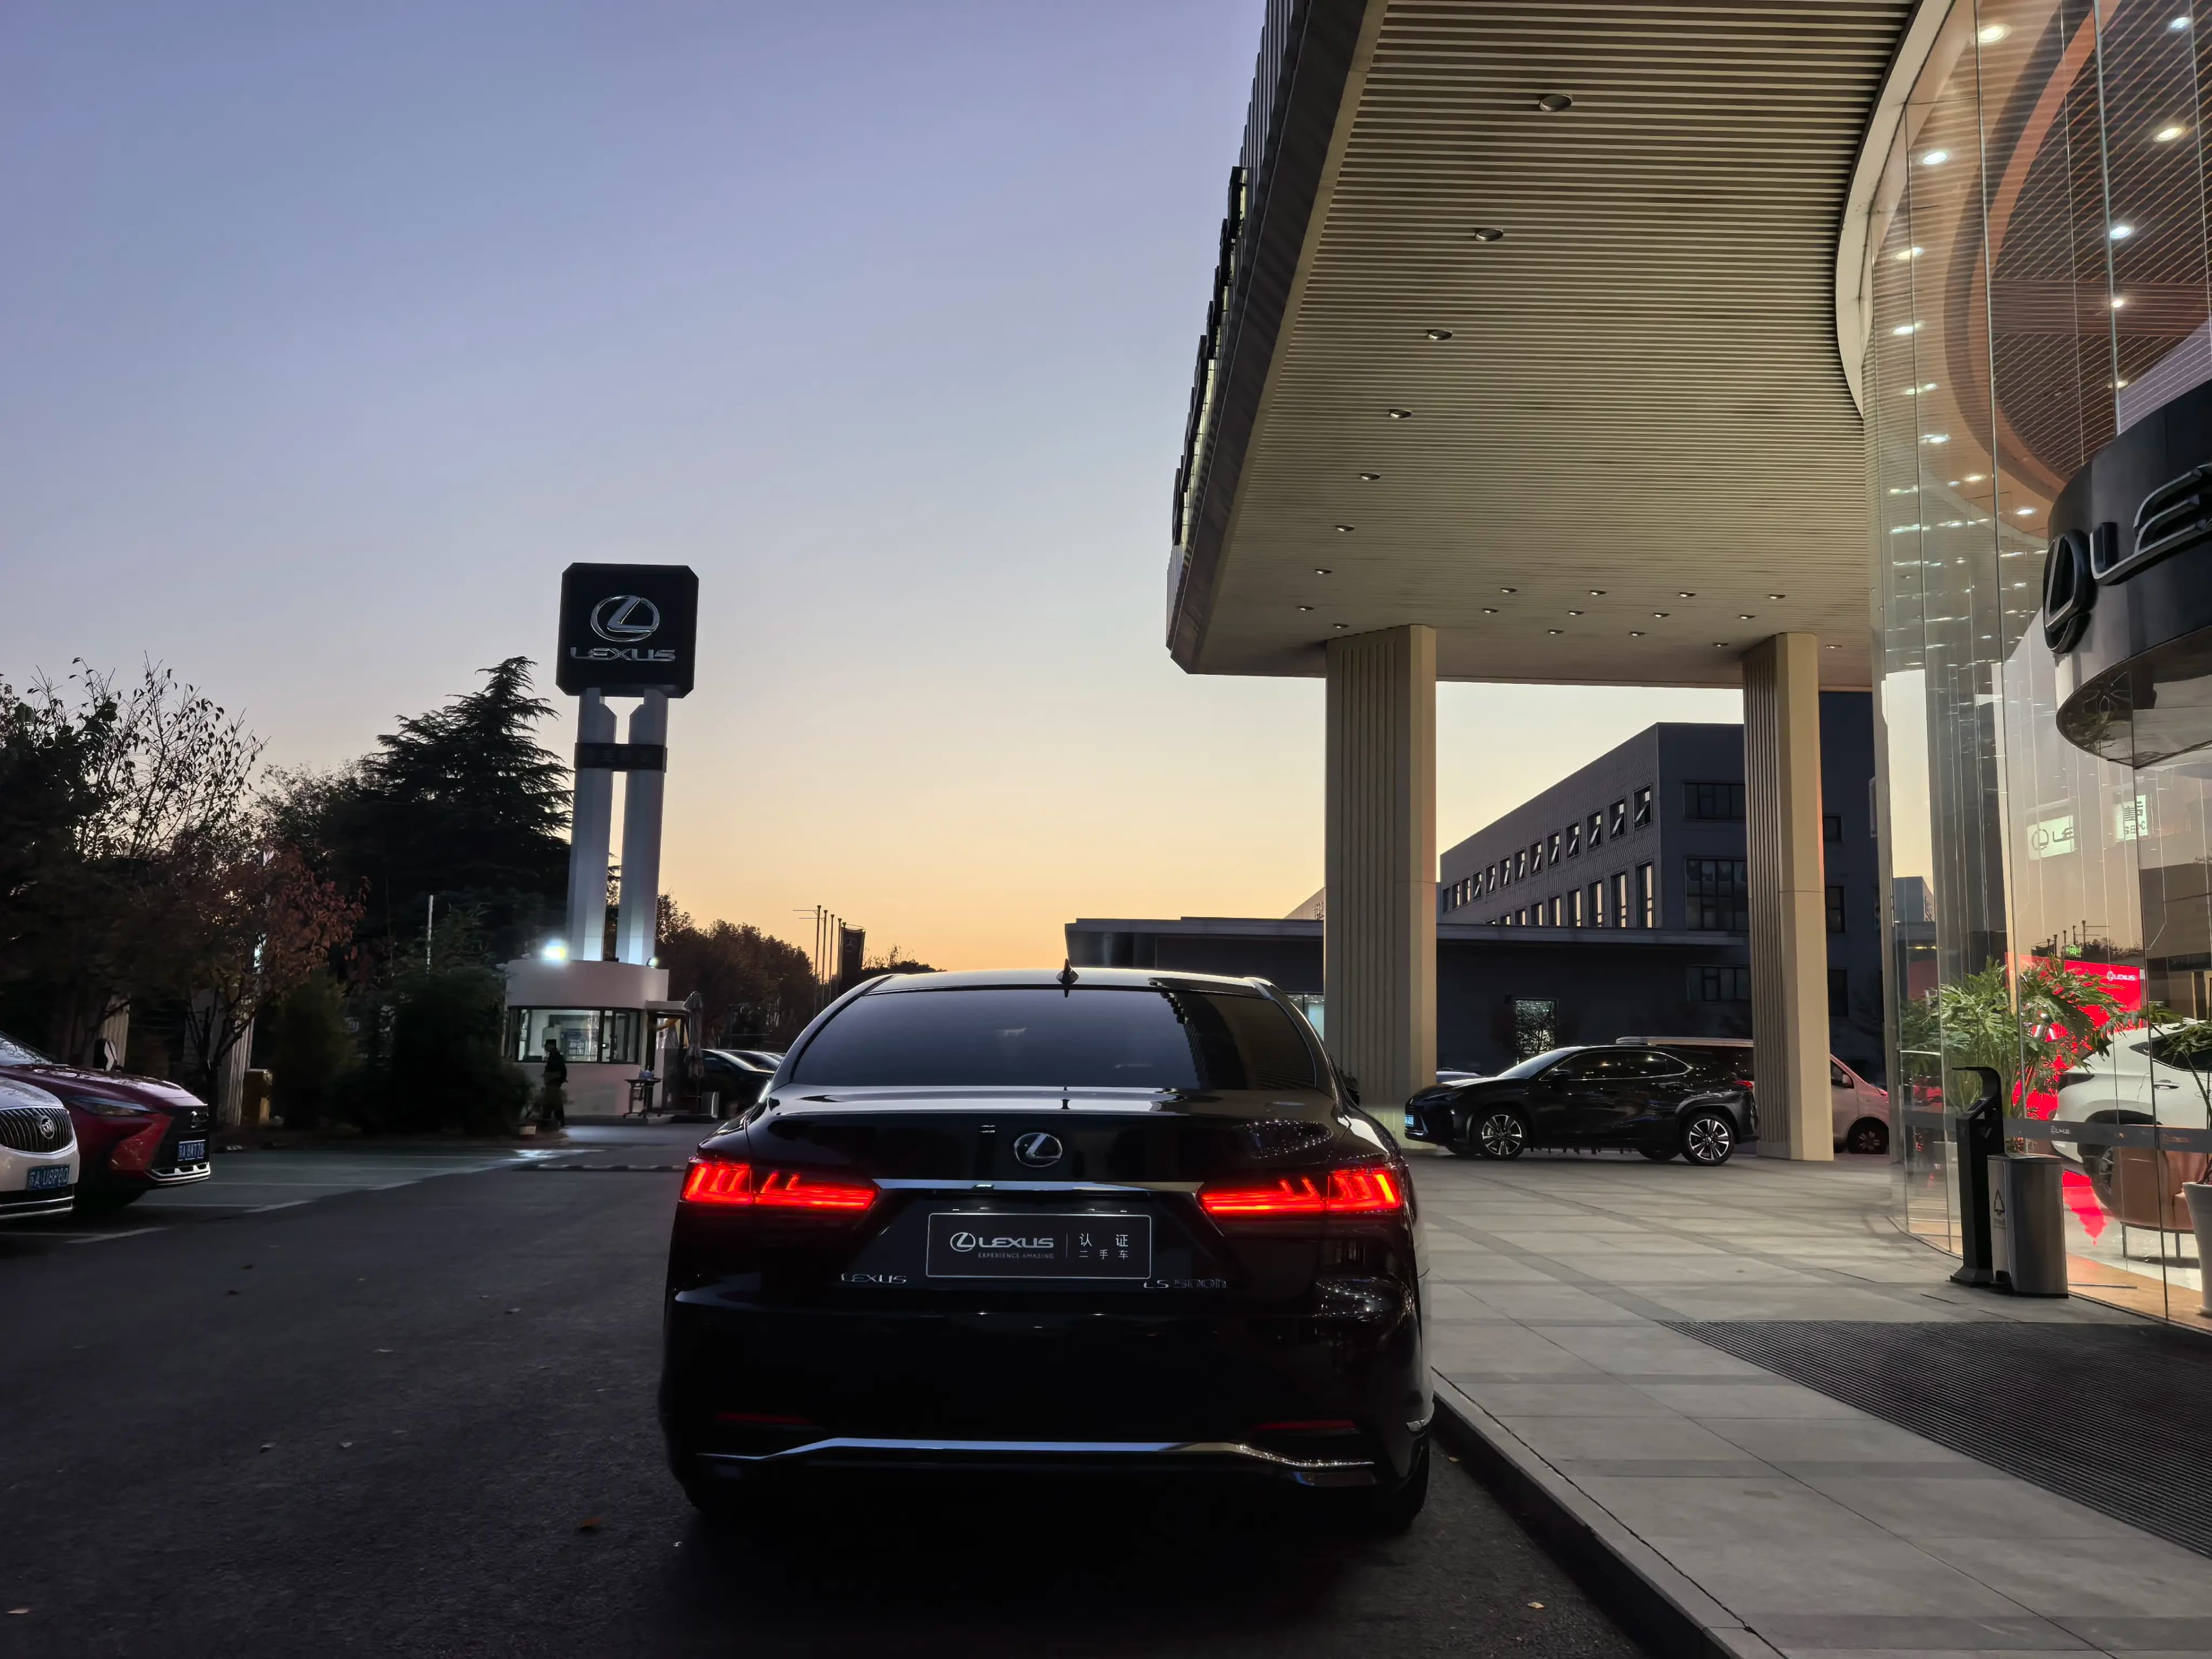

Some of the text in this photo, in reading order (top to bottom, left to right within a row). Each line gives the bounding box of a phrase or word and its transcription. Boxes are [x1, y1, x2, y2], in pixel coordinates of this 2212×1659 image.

[2090, 464, 2212, 586] LE
[570, 646, 676, 662] LEXUS
[979, 1237, 1054, 1248] LEXUS
[1079, 1233, 1129, 1247] 认证
[1079, 1249, 1129, 1260] 二手车
[841, 1273, 907, 1284] LEXUS
[1143, 1278, 1226, 1289] LS 500h
